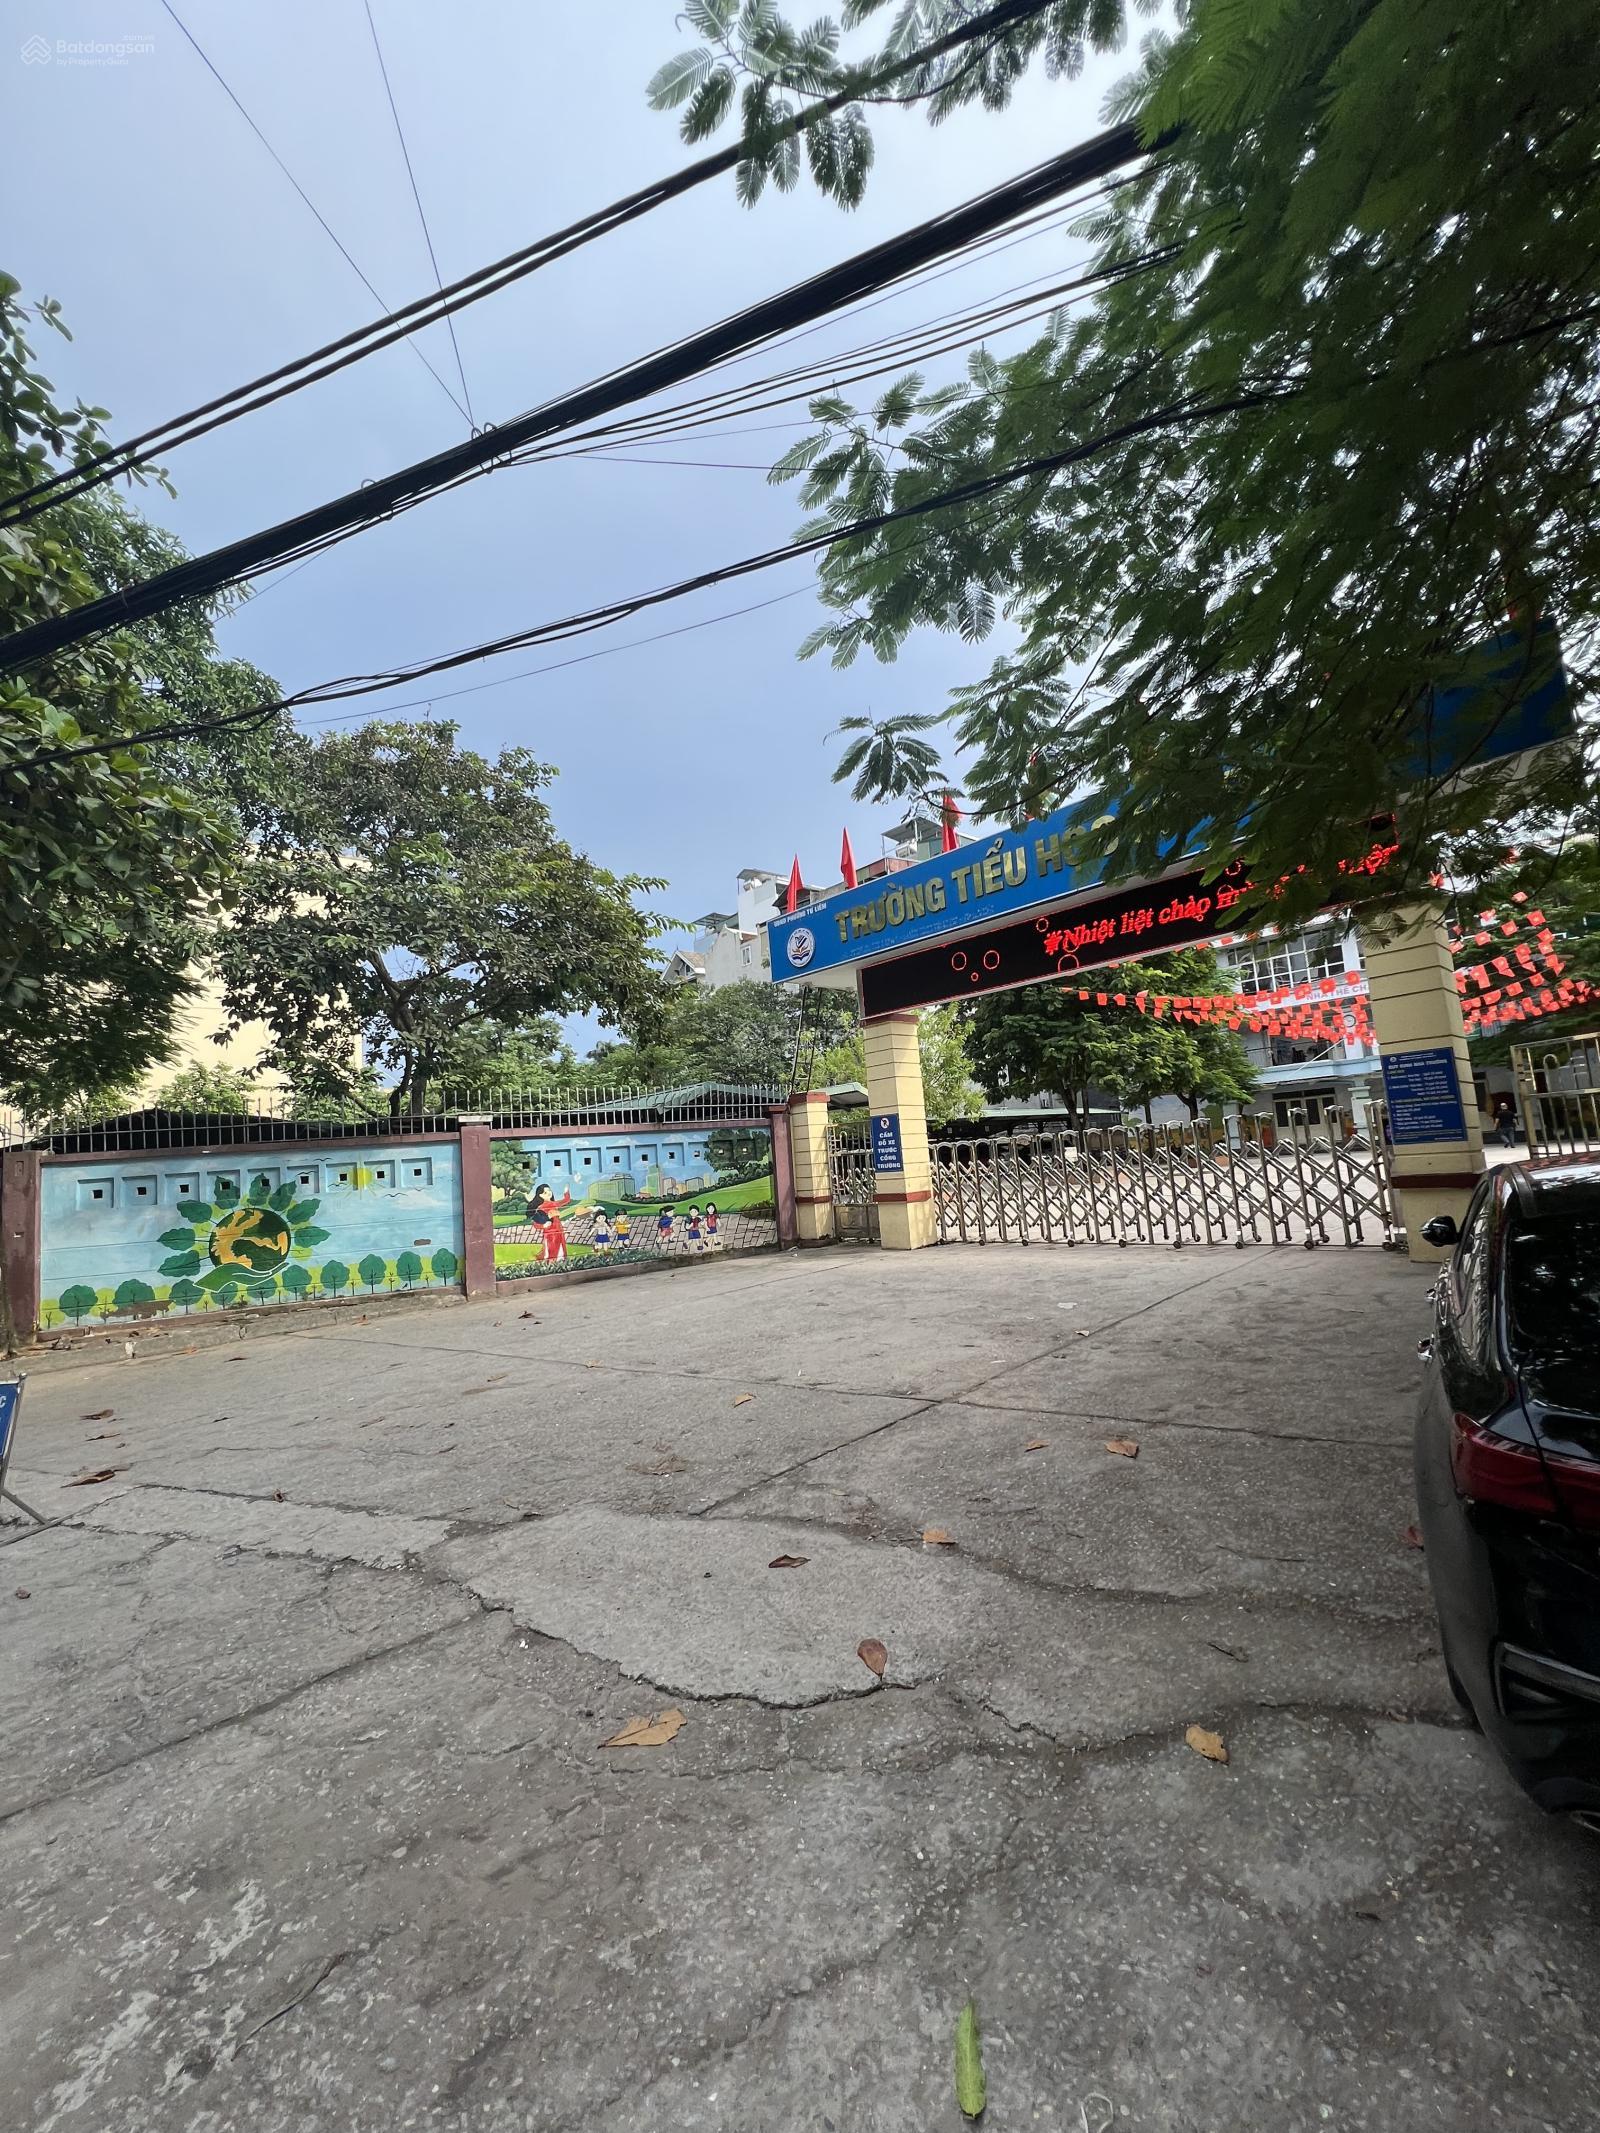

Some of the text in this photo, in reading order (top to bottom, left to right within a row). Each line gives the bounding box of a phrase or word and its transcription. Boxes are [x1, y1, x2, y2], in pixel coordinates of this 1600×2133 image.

[834, 877, 947, 943] TRƯỜNG
[951, 837, 1027, 904] TIỂU
[1063, 918, 1116, 947] Nhiệt
[1120, 906, 1154, 935] liệt
[1158, 894, 1211, 924] chào
